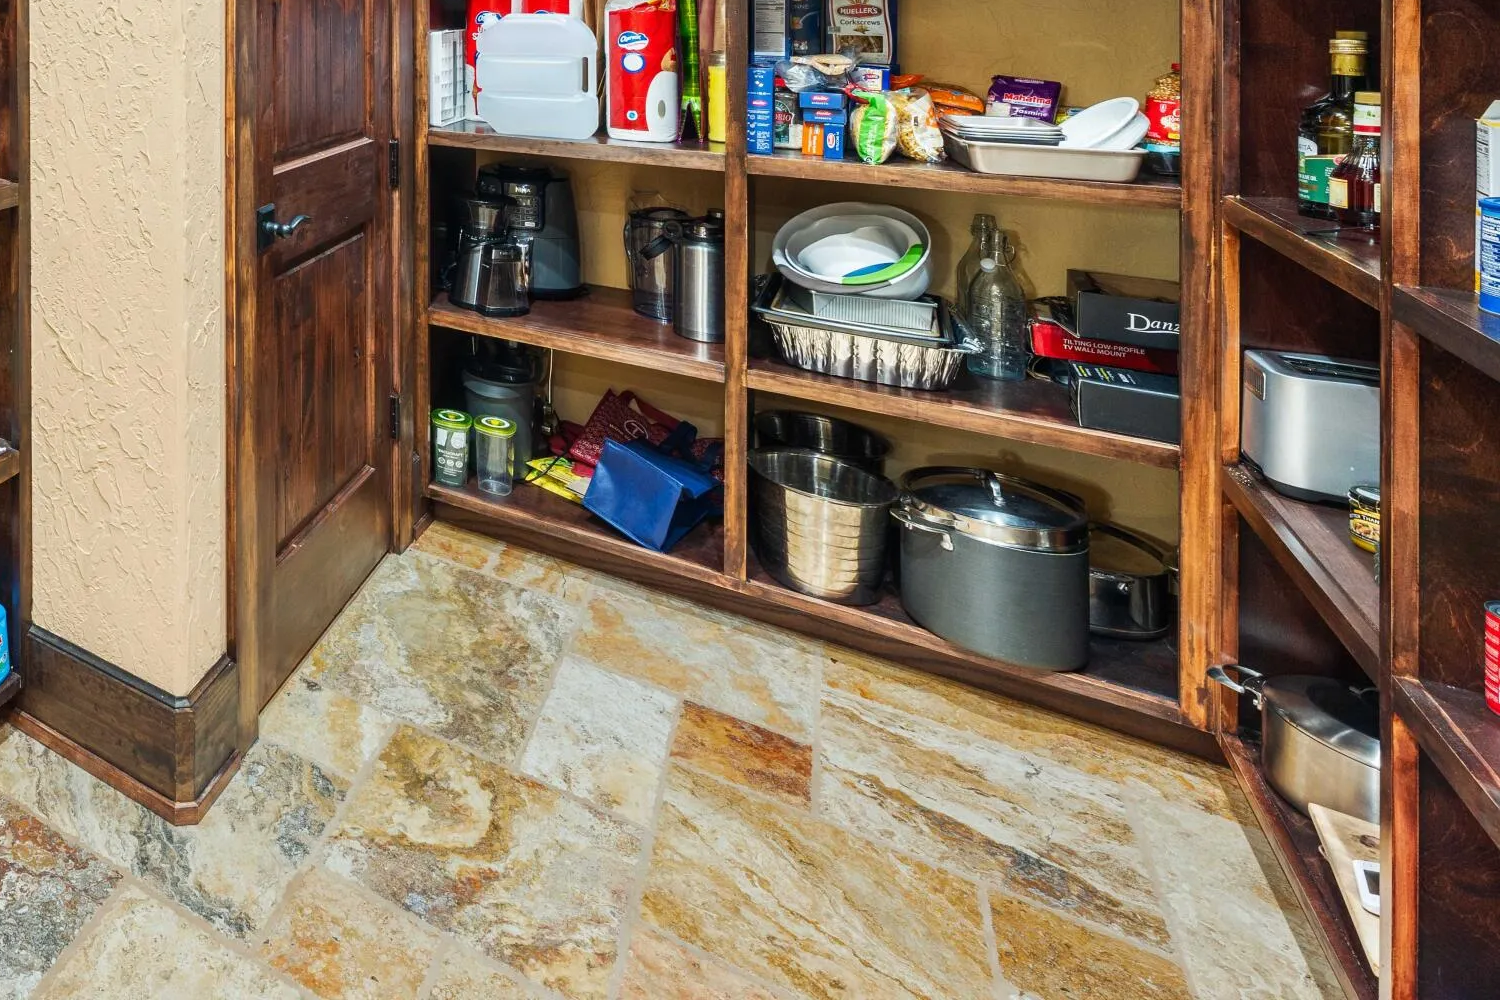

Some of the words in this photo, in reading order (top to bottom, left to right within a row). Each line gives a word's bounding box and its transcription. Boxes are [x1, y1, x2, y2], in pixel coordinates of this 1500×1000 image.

[840, 7, 878, 15] MUELLER'S
[840, 19, 880, 27] Corkscrews
[1003, 92, 1052, 105] Mahatma
[1011, 106, 1047, 118] Jasmine
[1063, 338, 1092, 348] TILTING
[1093, 343, 1145, 355] LOW-PROFILE
[1074, 346, 1096, 354] WALL
[1097, 349, 1127, 358] MOUNT
